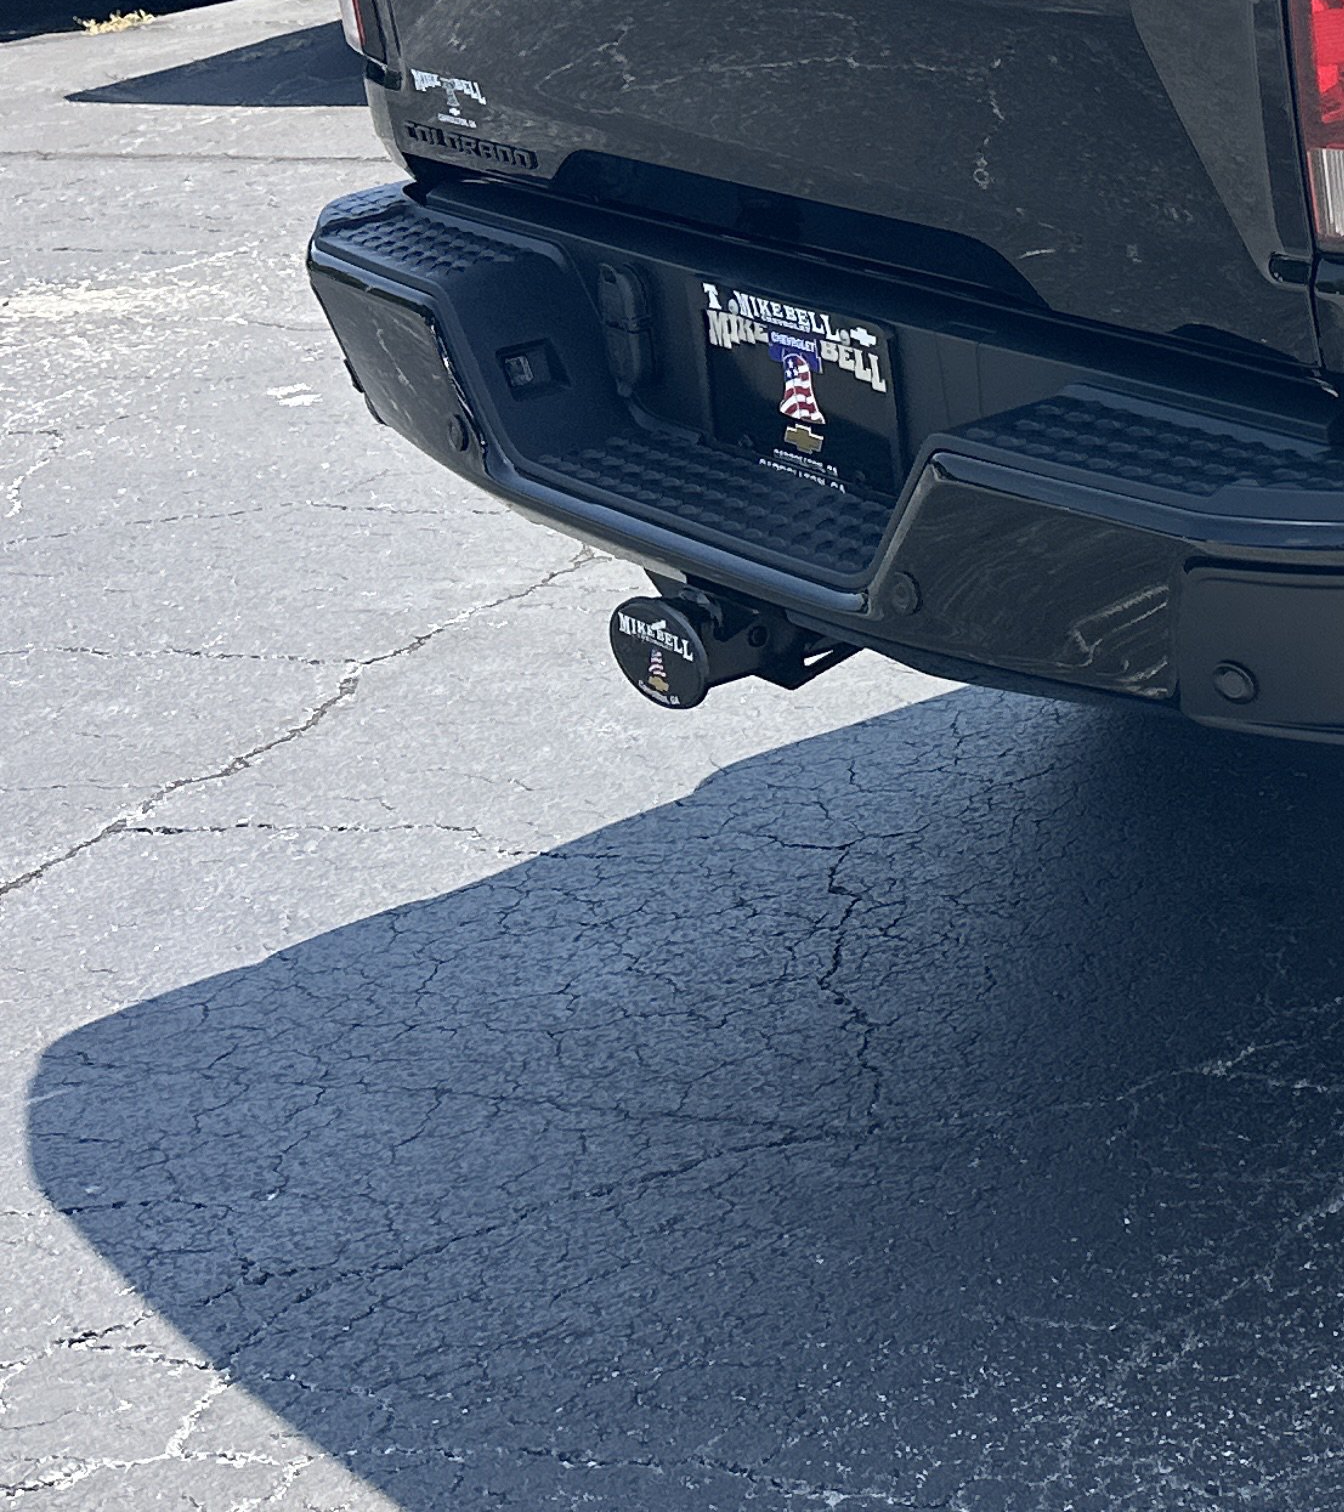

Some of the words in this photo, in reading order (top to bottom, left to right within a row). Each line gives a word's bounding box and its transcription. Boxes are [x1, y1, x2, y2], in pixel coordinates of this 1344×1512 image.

[405, 120, 539, 170] COLORADO
[733, 289, 783, 320] MIKE
[784, 304, 841, 342] BELL
[706, 309, 770, 350] MIKE
[820, 339, 887, 393] BELL
[618, 611, 656, 638] MIKE
[656, 628, 694, 662] BELL
